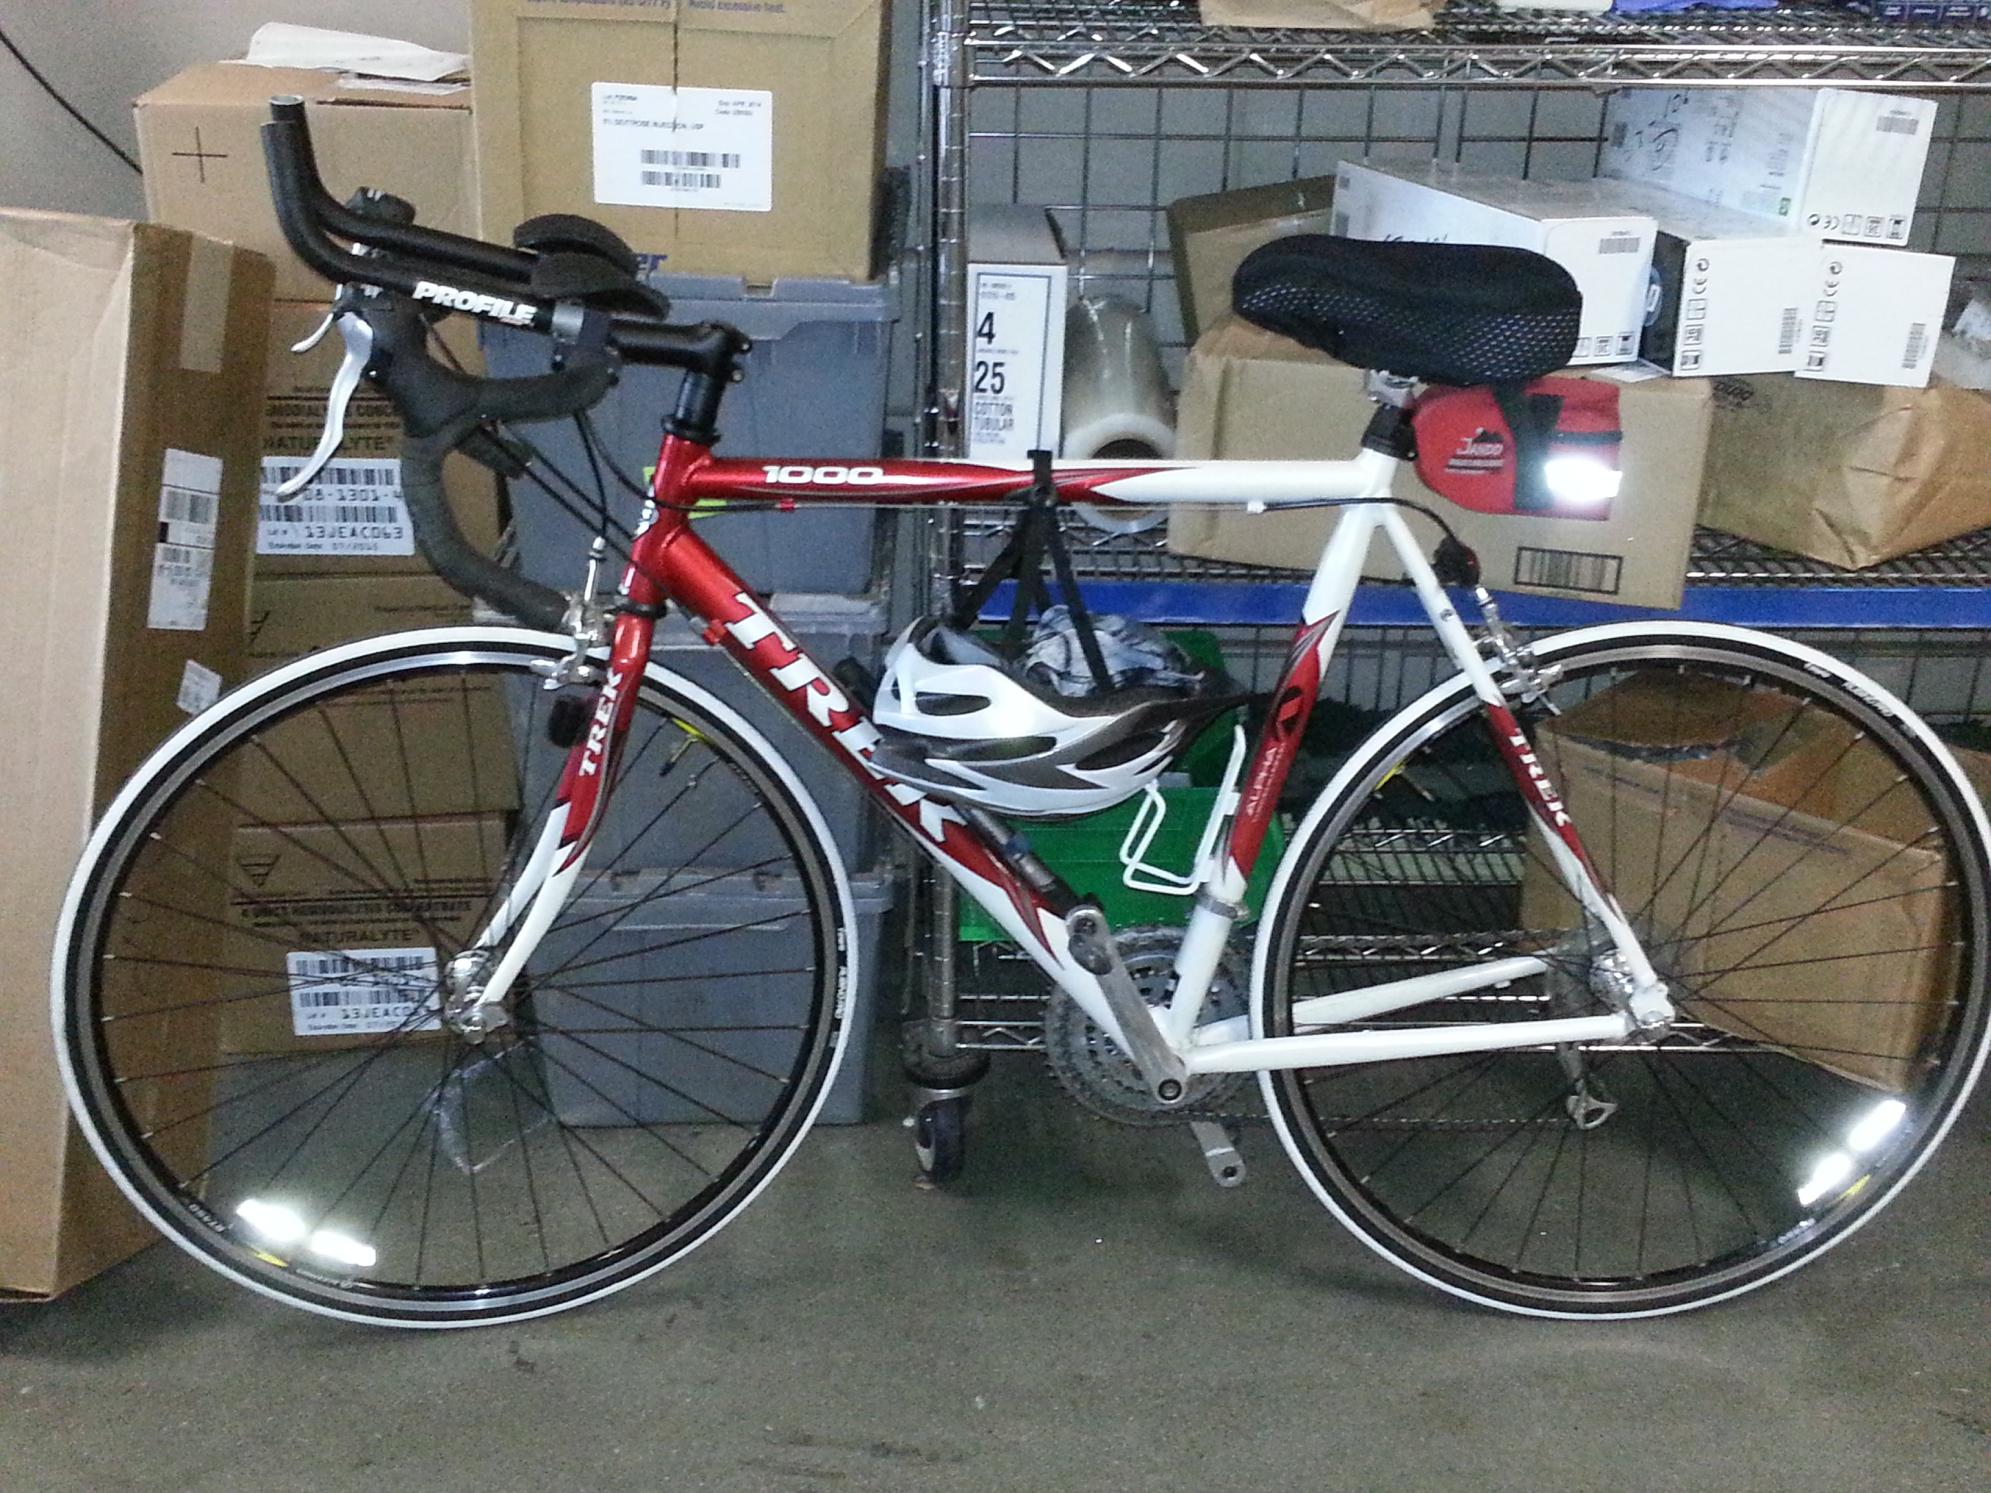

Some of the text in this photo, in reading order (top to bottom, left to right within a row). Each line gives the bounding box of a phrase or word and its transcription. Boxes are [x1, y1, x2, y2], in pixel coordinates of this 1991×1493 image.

[411, 280, 537, 325] PROFILE
[976, 311, 996, 344] 4
[974, 360, 1006, 394] 25
[762, 466, 884, 485] 1000
[578, 666, 623, 778] TREK
[724, 592, 968, 843] TREK
[1508, 727, 1573, 828] TREK
